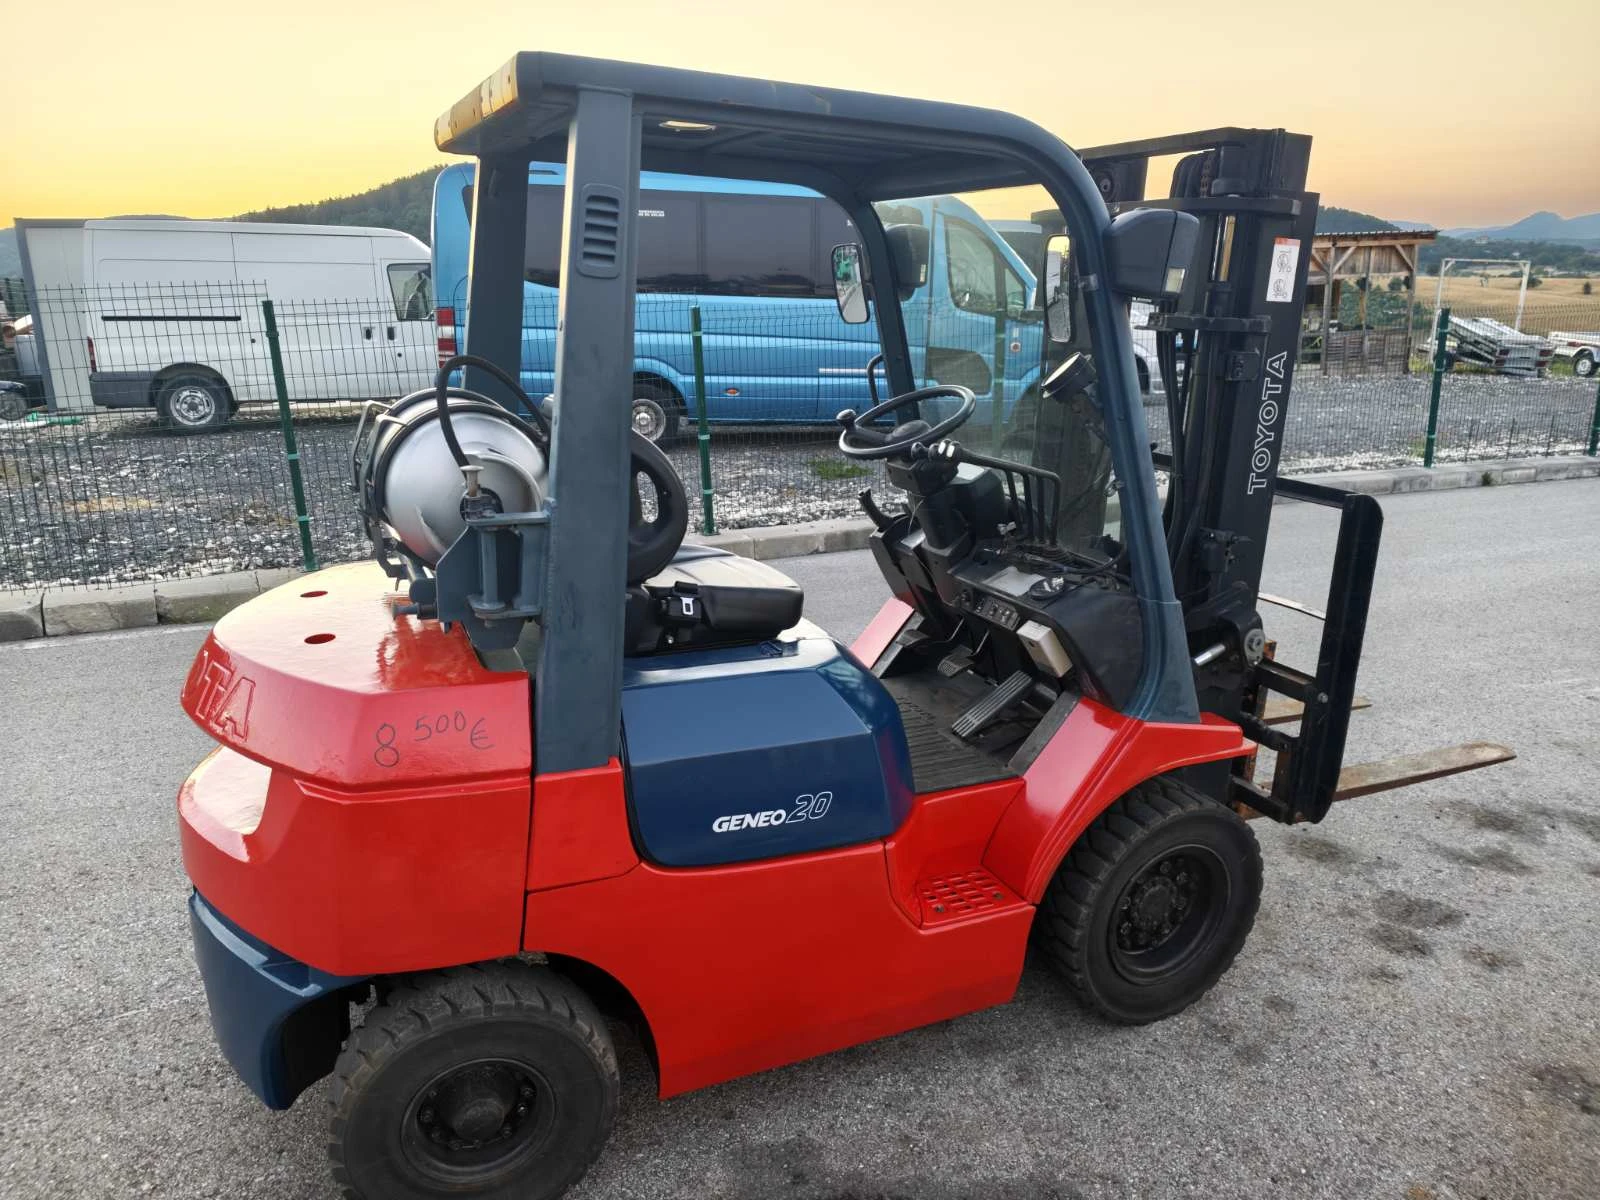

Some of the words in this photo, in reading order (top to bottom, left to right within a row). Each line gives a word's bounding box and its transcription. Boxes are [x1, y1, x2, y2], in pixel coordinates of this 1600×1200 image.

[1247, 351, 1288, 495] TOYOTA
[196, 650, 256, 742] TA
[712, 809, 787, 833] GENEO
[785, 791, 833, 824] 20
